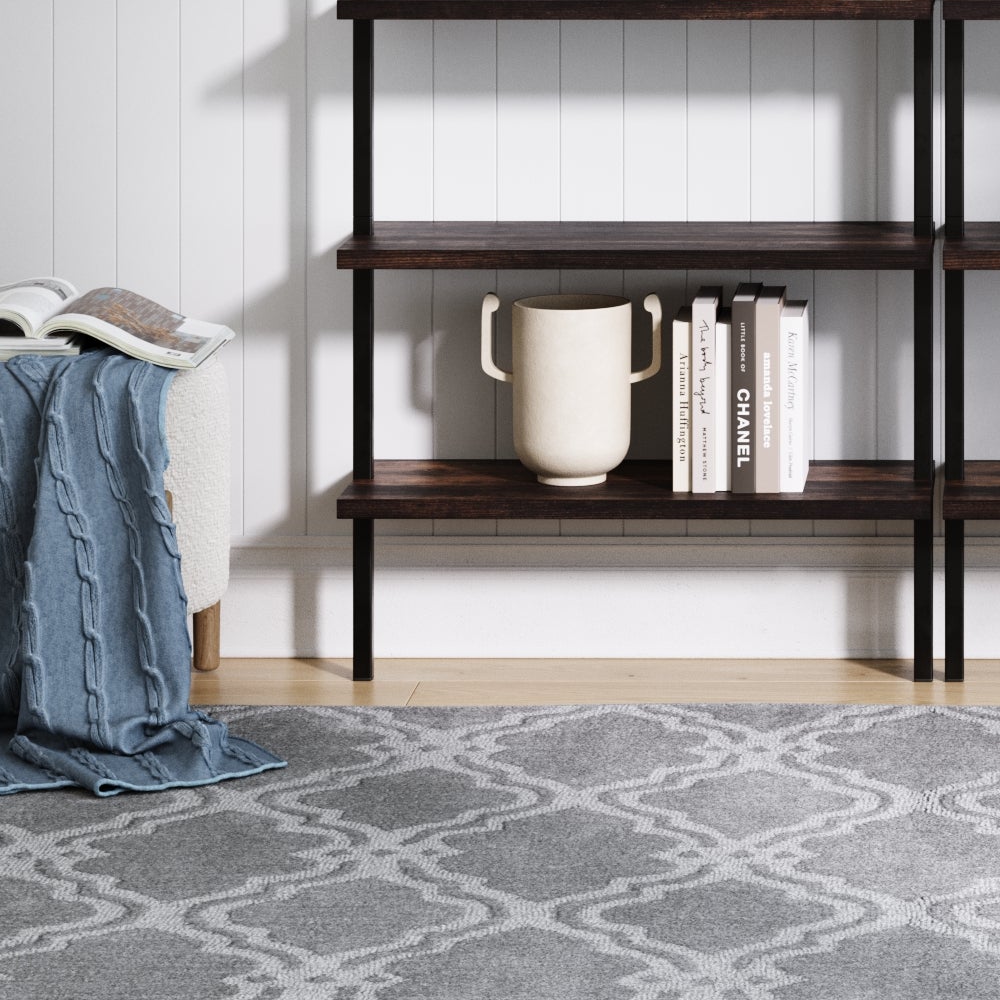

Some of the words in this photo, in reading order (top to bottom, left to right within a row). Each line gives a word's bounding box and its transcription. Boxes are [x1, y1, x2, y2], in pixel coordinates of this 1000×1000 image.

[787, 331, 798, 358] Karen
[679, 353, 689, 396] Arianna
[740, 364, 746, 373] OF
[762, 352, 773, 398] amanda
[784, 361, 798, 410] McCartney
[677, 401, 689, 462] Huffington
[737, 388, 750, 468] CHANEL
[762, 401, 773, 448] lovelace
